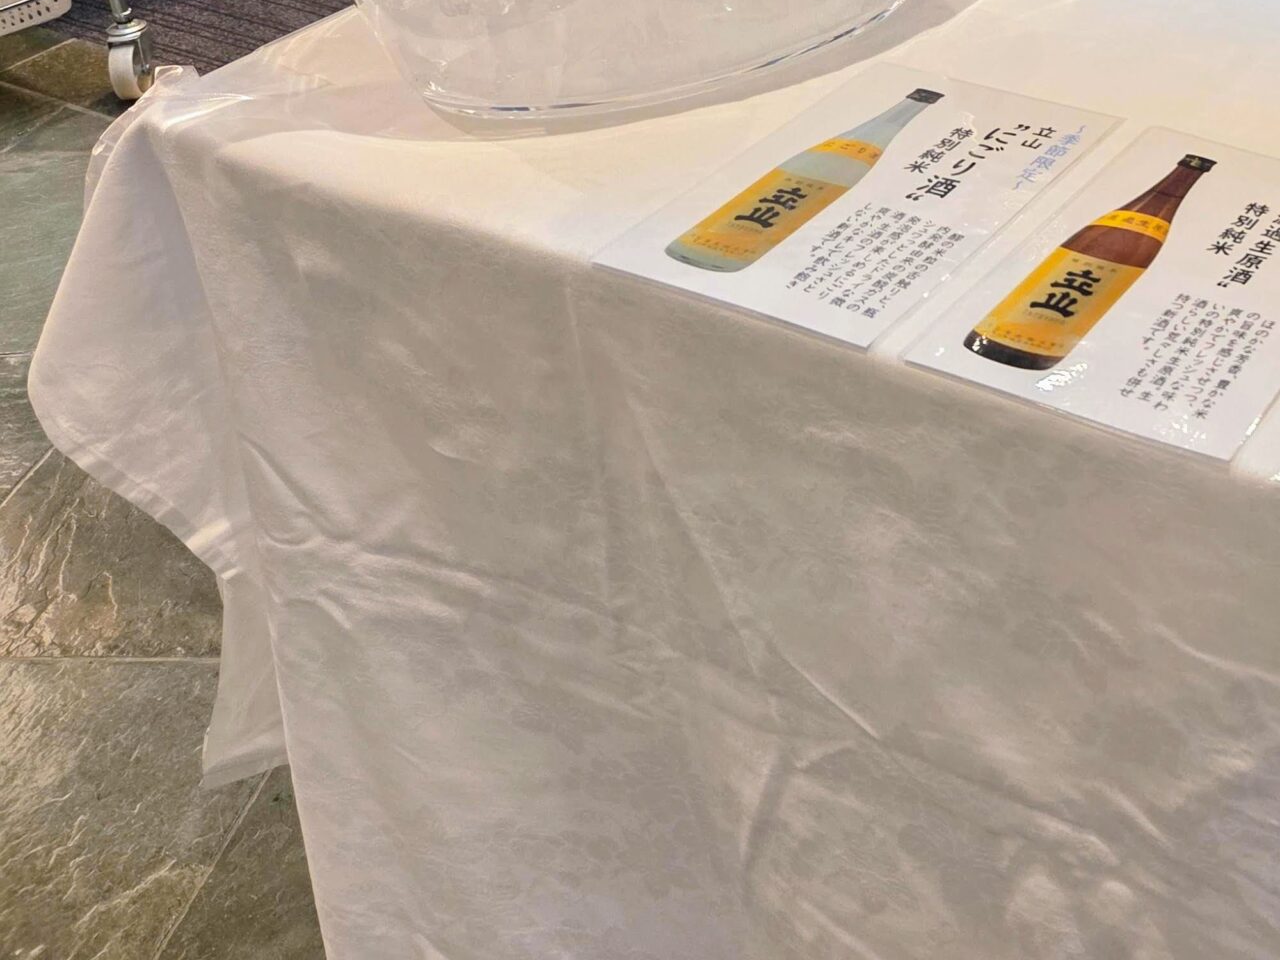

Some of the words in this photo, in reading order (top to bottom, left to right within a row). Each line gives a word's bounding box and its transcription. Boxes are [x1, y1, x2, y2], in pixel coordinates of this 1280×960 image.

[903, 126, 974, 174] 特別純米
[1019, 126, 1057, 149] 立山
[734, 186, 808, 229] 立山
[809, 202, 872, 257] しない新酒です。
[1205, 201, 1270, 256] 特別純米
[1030, 268, 1102, 319] 立山
[1142, 292, 1191, 350] 持つ新酒です。
[1152, 307, 1244, 411] 爽やかでフレッシュな味わ
[1184, 312, 1261, 407] の旨味を感じさせつつ、
